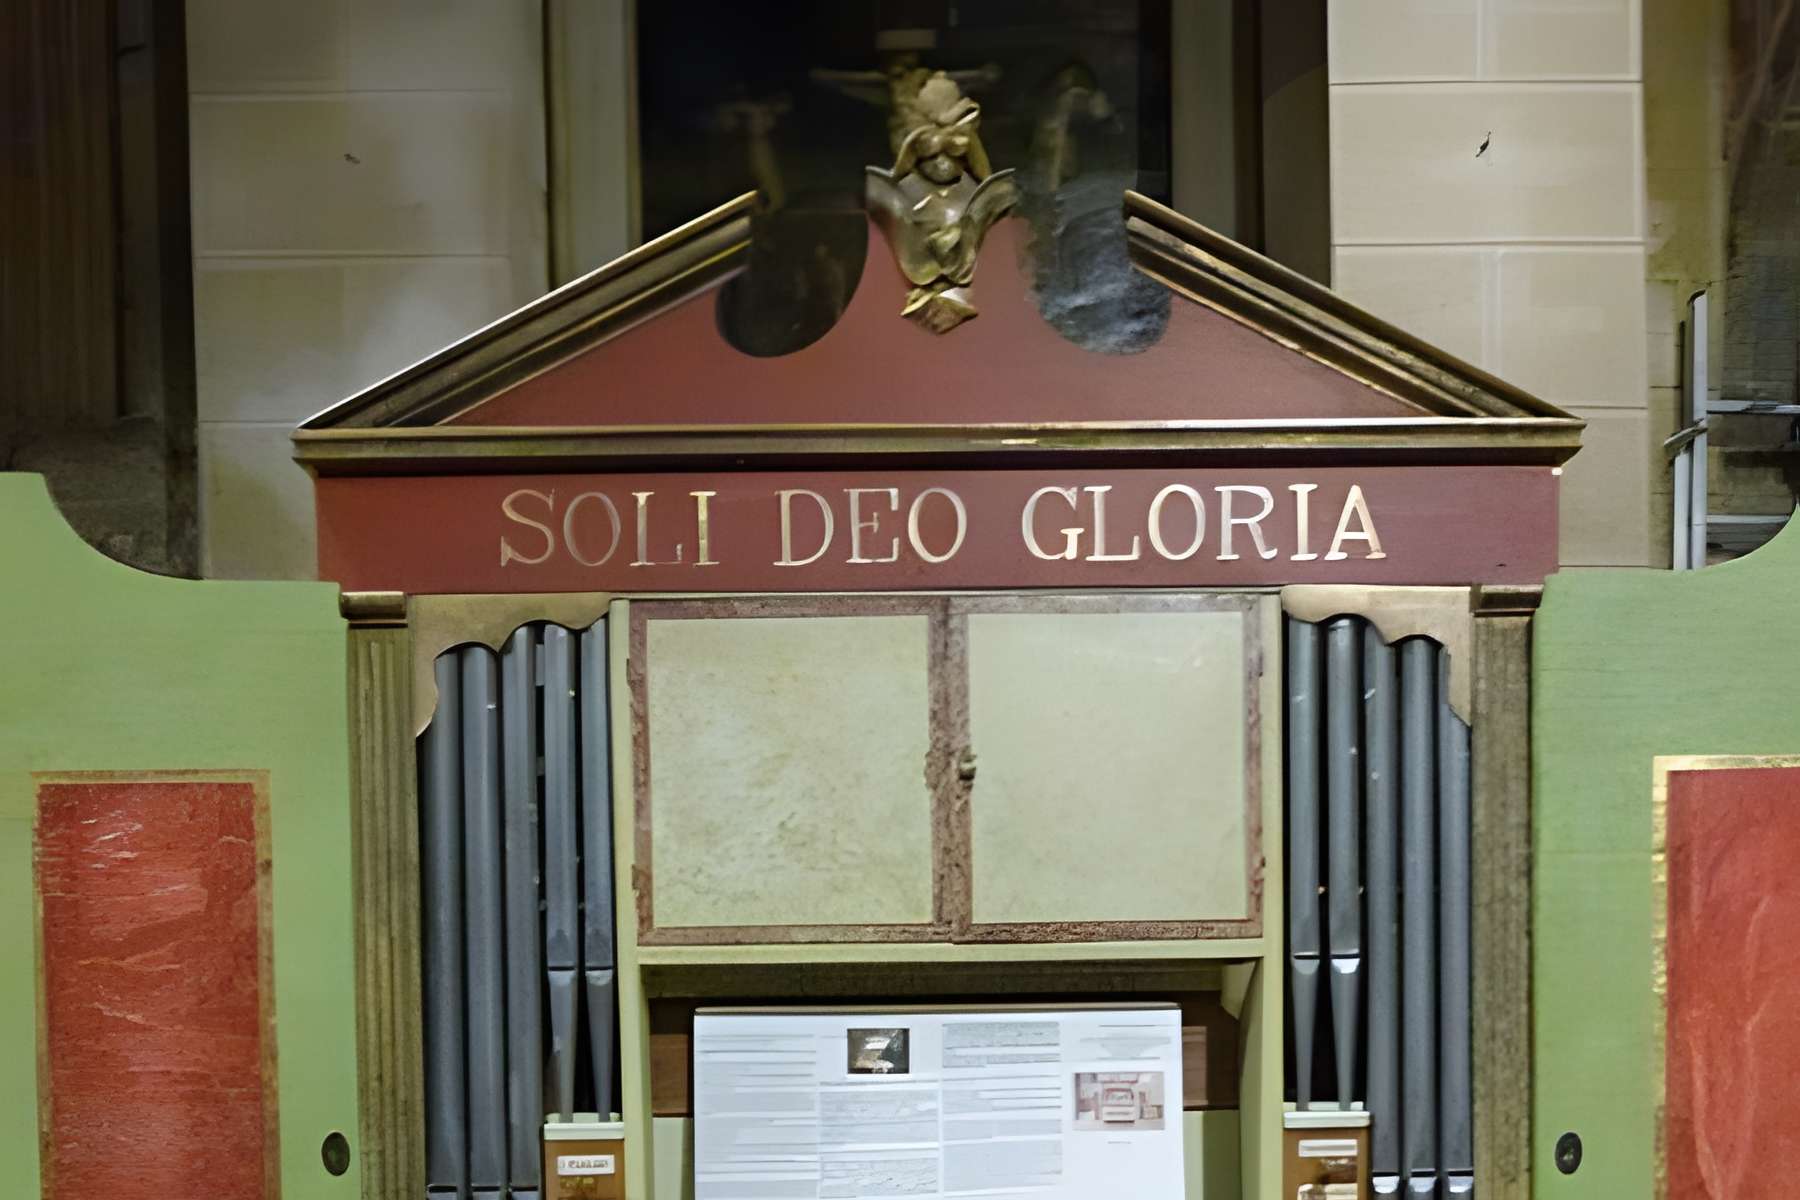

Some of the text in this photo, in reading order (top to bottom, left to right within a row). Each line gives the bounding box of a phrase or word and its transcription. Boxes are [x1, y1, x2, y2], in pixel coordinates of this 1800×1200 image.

[501, 483, 1387, 567] SOLI DEO GLORIA
